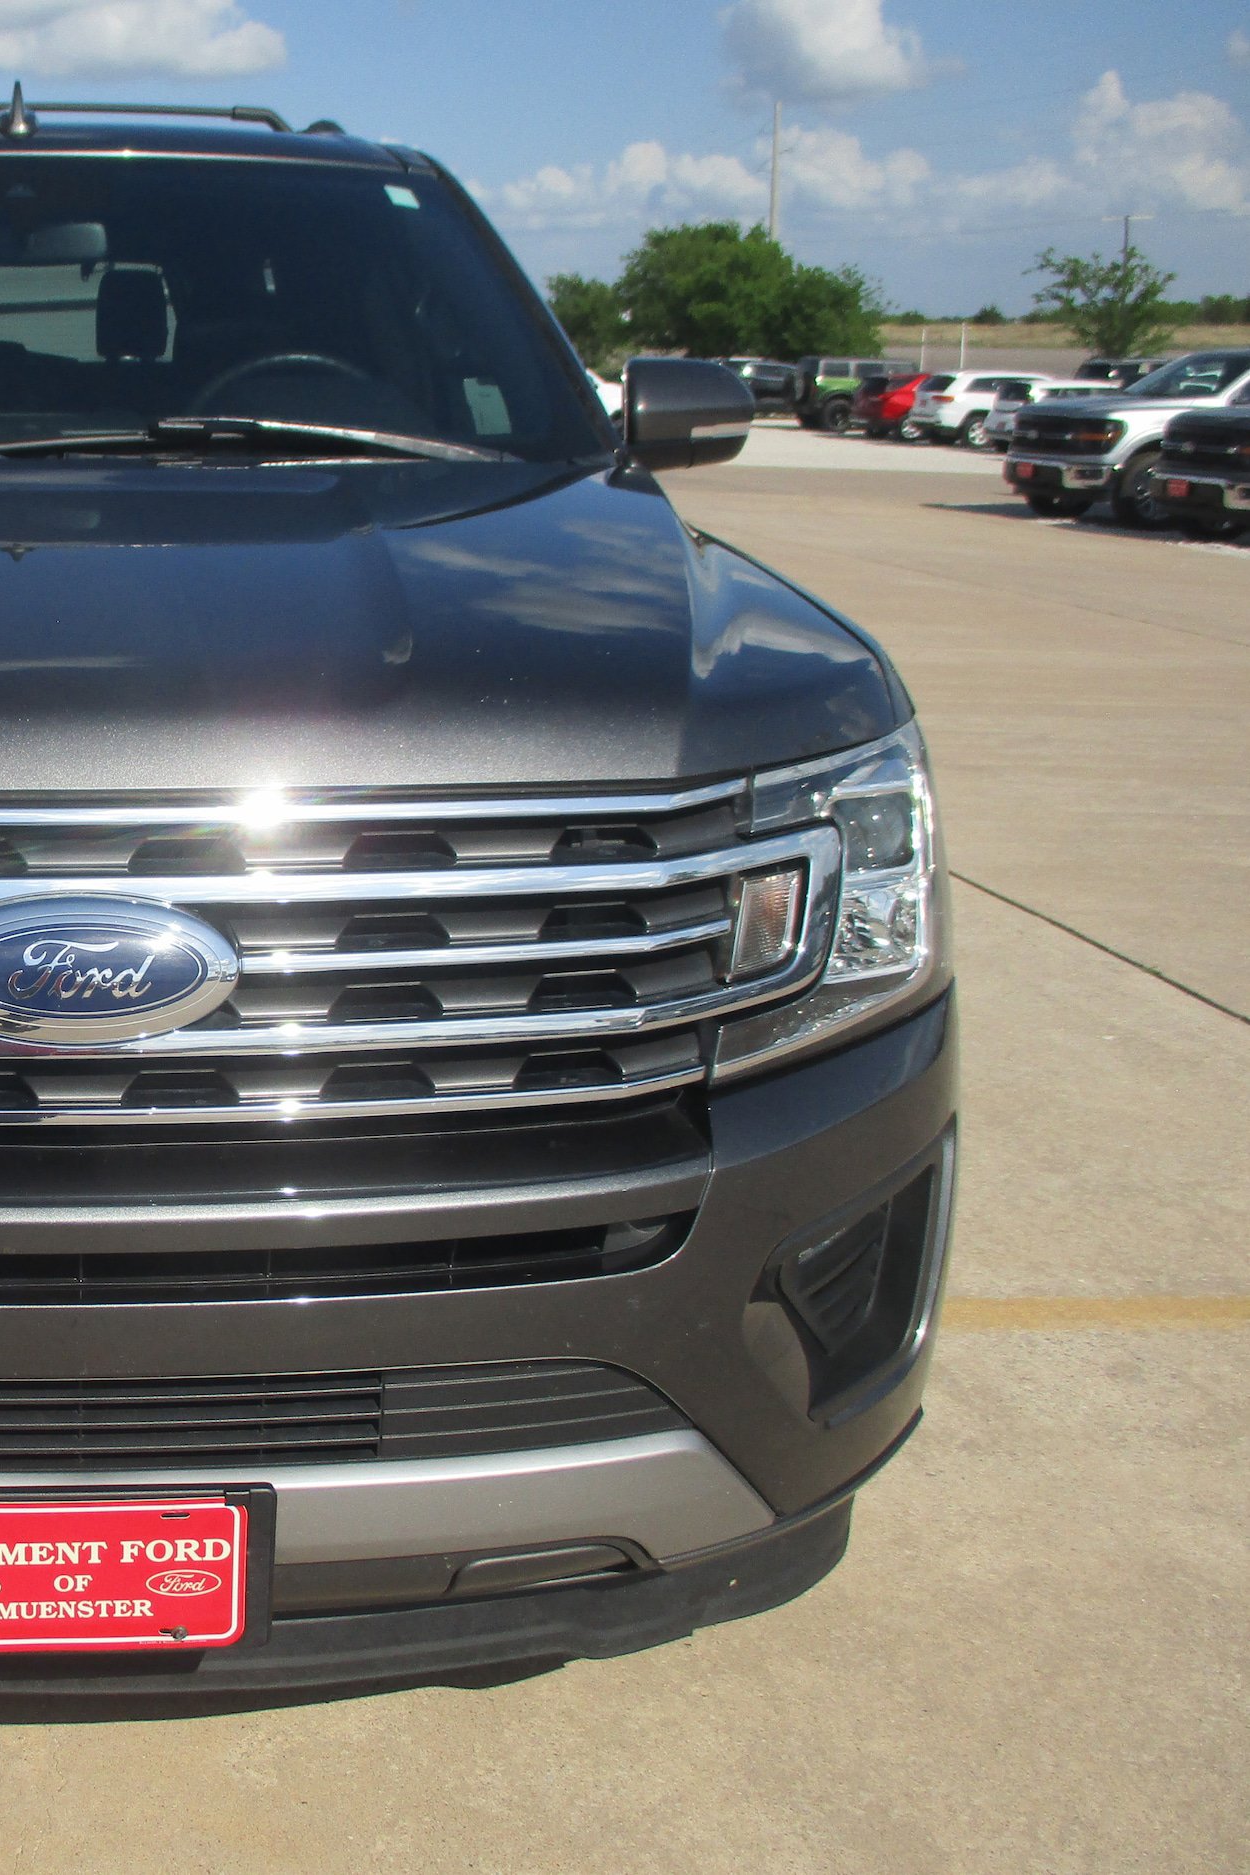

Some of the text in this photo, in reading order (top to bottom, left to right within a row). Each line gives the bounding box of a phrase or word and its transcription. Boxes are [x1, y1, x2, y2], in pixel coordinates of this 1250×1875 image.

[7, 939, 156, 999] Ford
[119, 1538, 231, 1563] FORD
[53, 1574, 93, 1593] OF
[159, 1573, 206, 1592] Ford
